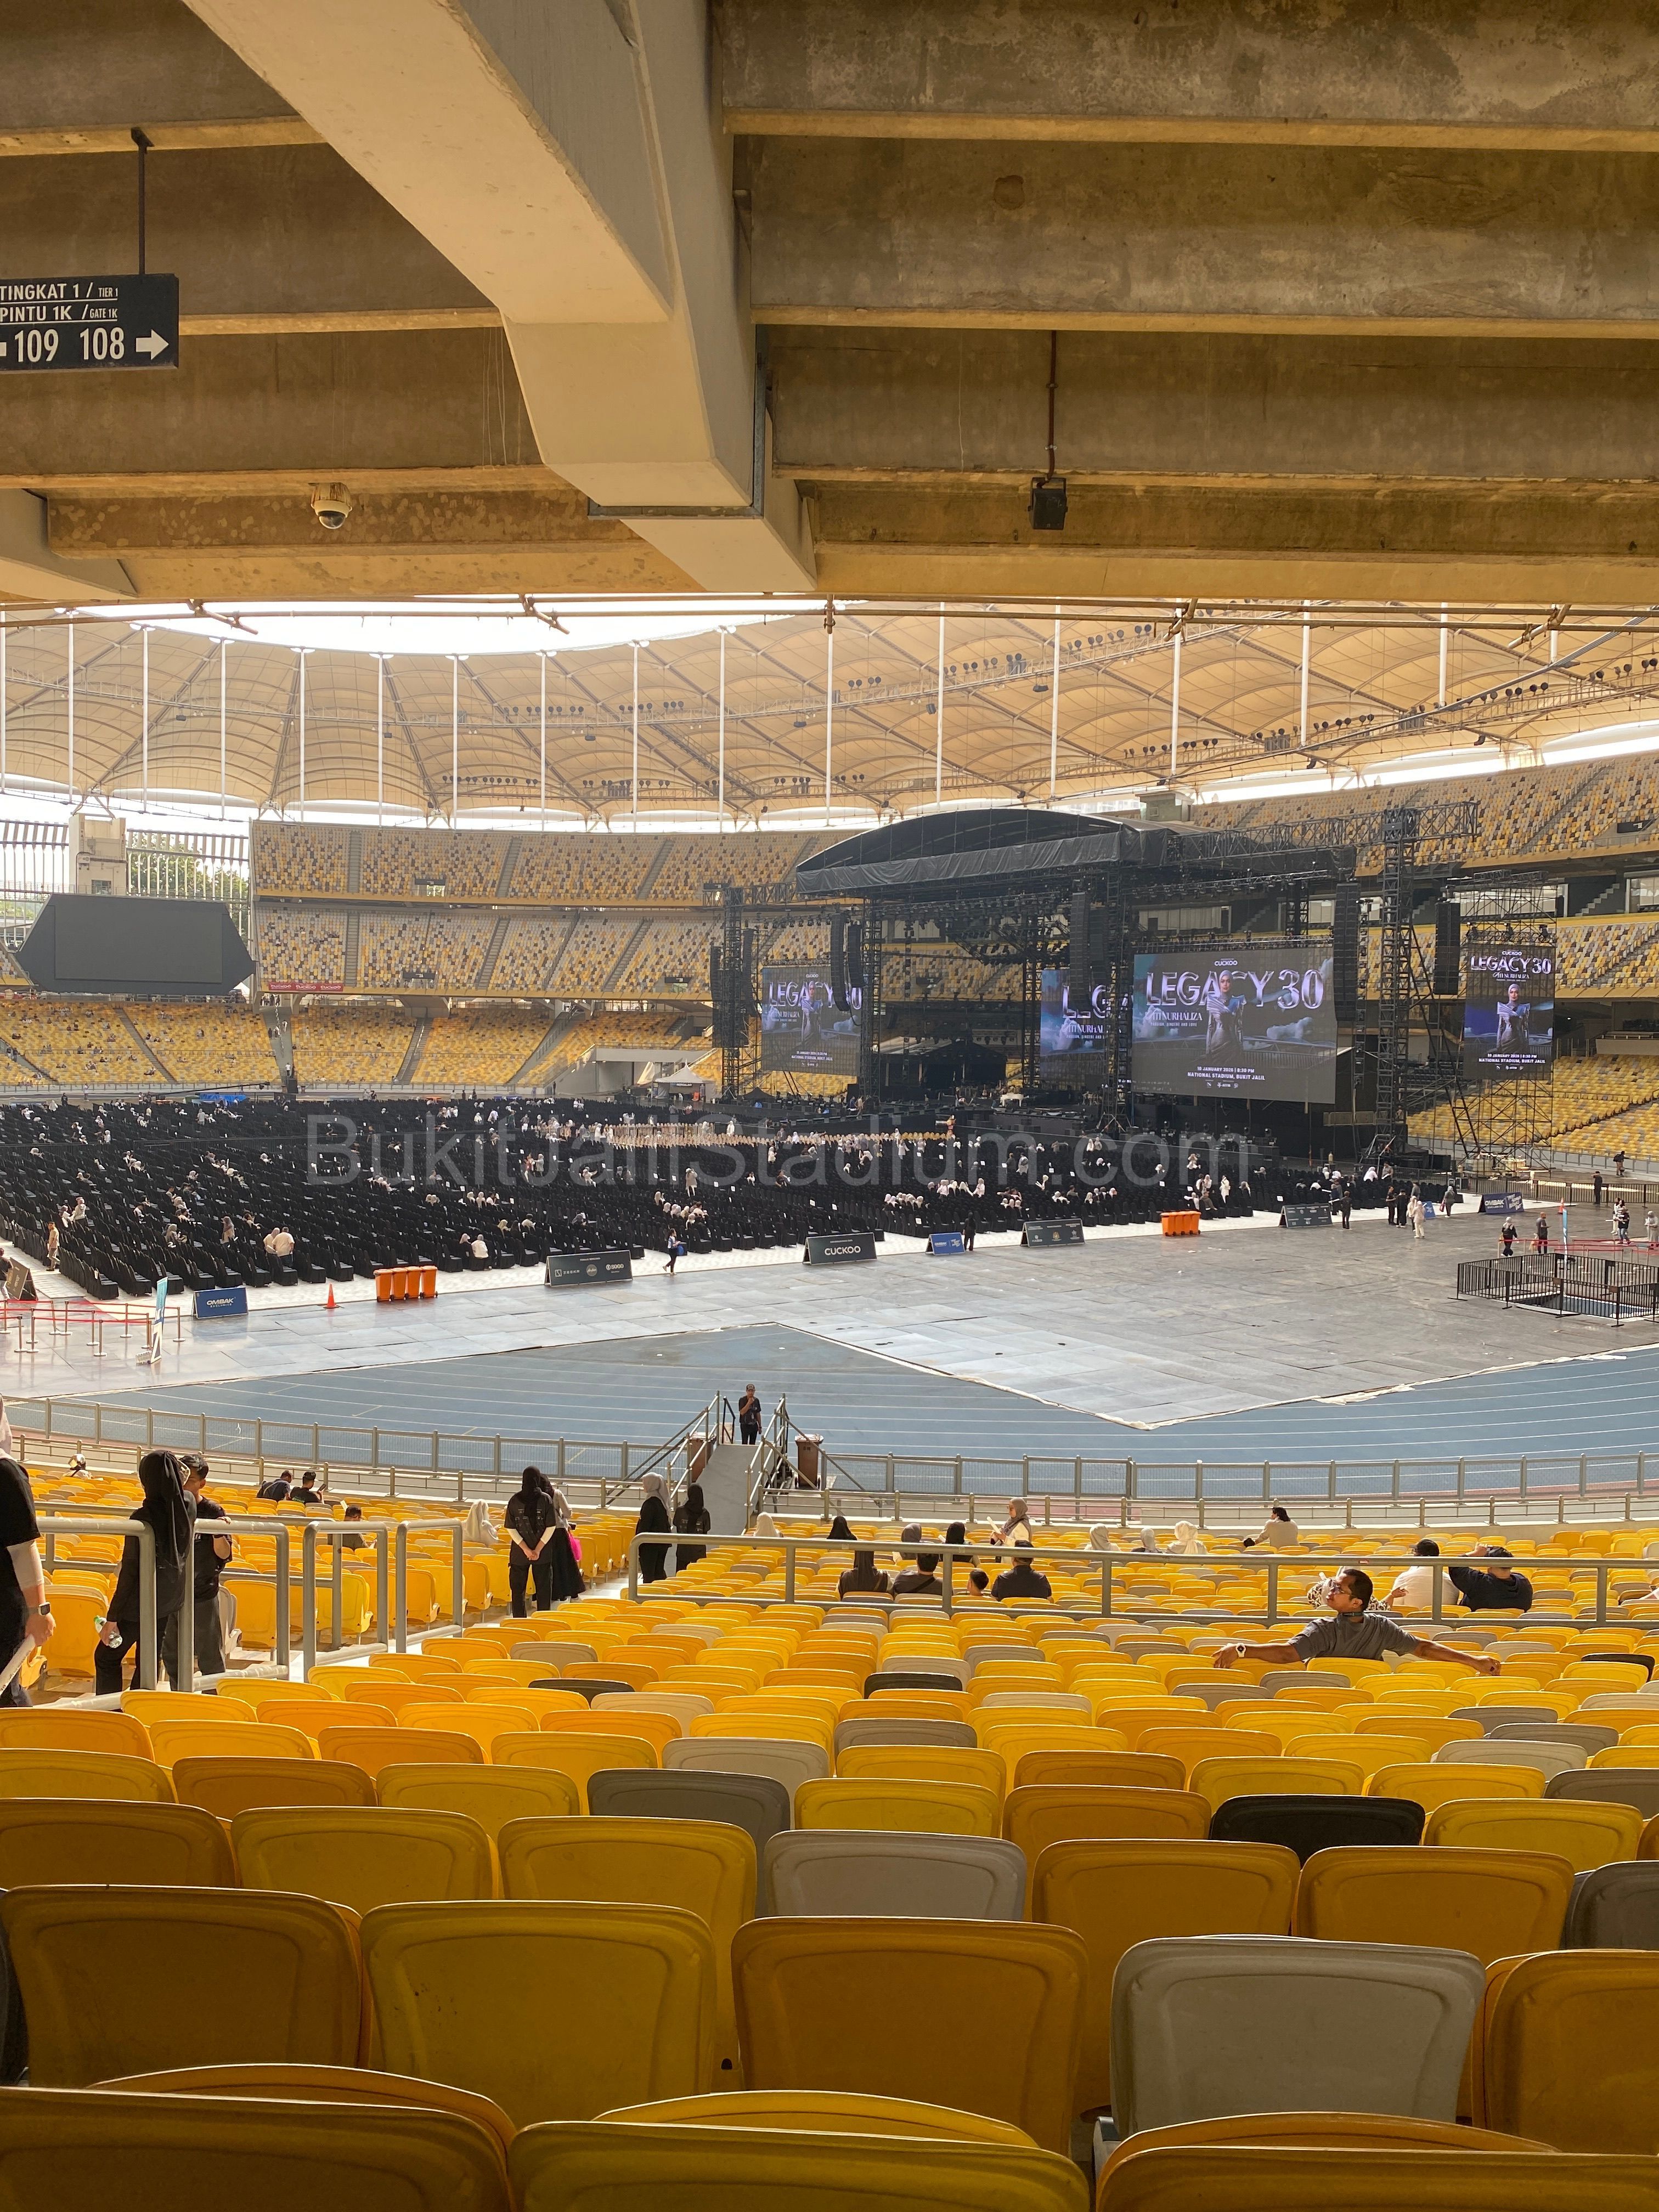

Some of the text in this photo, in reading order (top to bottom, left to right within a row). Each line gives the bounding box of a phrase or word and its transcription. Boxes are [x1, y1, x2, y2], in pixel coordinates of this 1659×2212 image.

[0, 283, 66, 301] TINGKAT
[73, 284, 80, 298] 1
[98, 287, 113, 297] TIER
[115, 287, 119, 297] 1
[0, 306, 47, 322] PINTU
[53, 306, 72, 320] 1K
[90, 308, 106, 319] GATE
[109, 308, 118, 318] 1K
[14, 327, 125, 362] 109 108
[1470, 955, 1551, 974] LEGACY 30
[1278, 969, 1325, 1009] 30
[825, 1245, 861, 1255] CUCKOO
